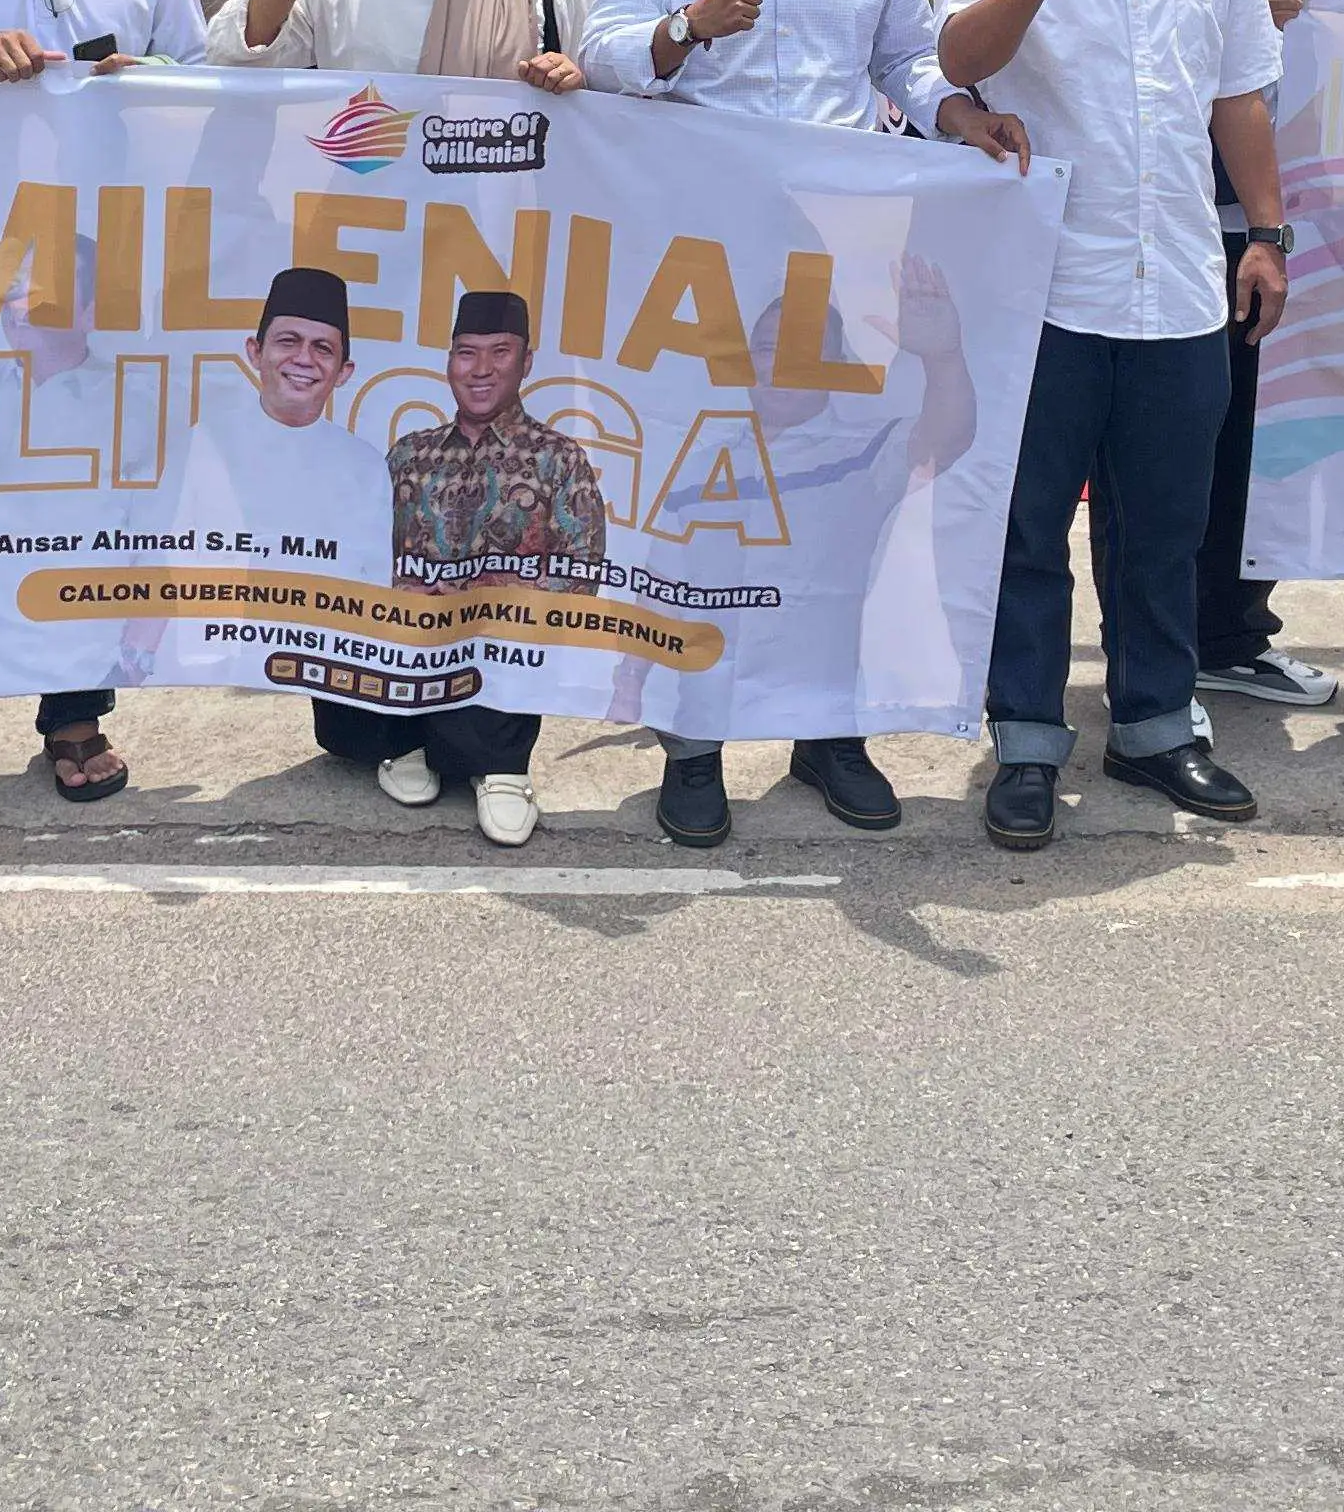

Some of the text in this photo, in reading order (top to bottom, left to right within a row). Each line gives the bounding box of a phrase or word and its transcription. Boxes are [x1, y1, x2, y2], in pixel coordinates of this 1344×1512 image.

[424, 114, 542, 139] Centre Of
[424, 138, 537, 165] Millenial
[92, 529, 195, 553] Ahmad
[206, 530, 270, 558] S.E.,
[281, 535, 338, 561] M.M
[548, 553, 627, 586] Haris
[632, 569, 782, 609] Pratamura
[59, 583, 684, 656] CALON GUBERNUR DAN CALON WAKIL GUBERNUR
[205, 623, 545, 671] PROVINSI KEPULAUAN RIAU
